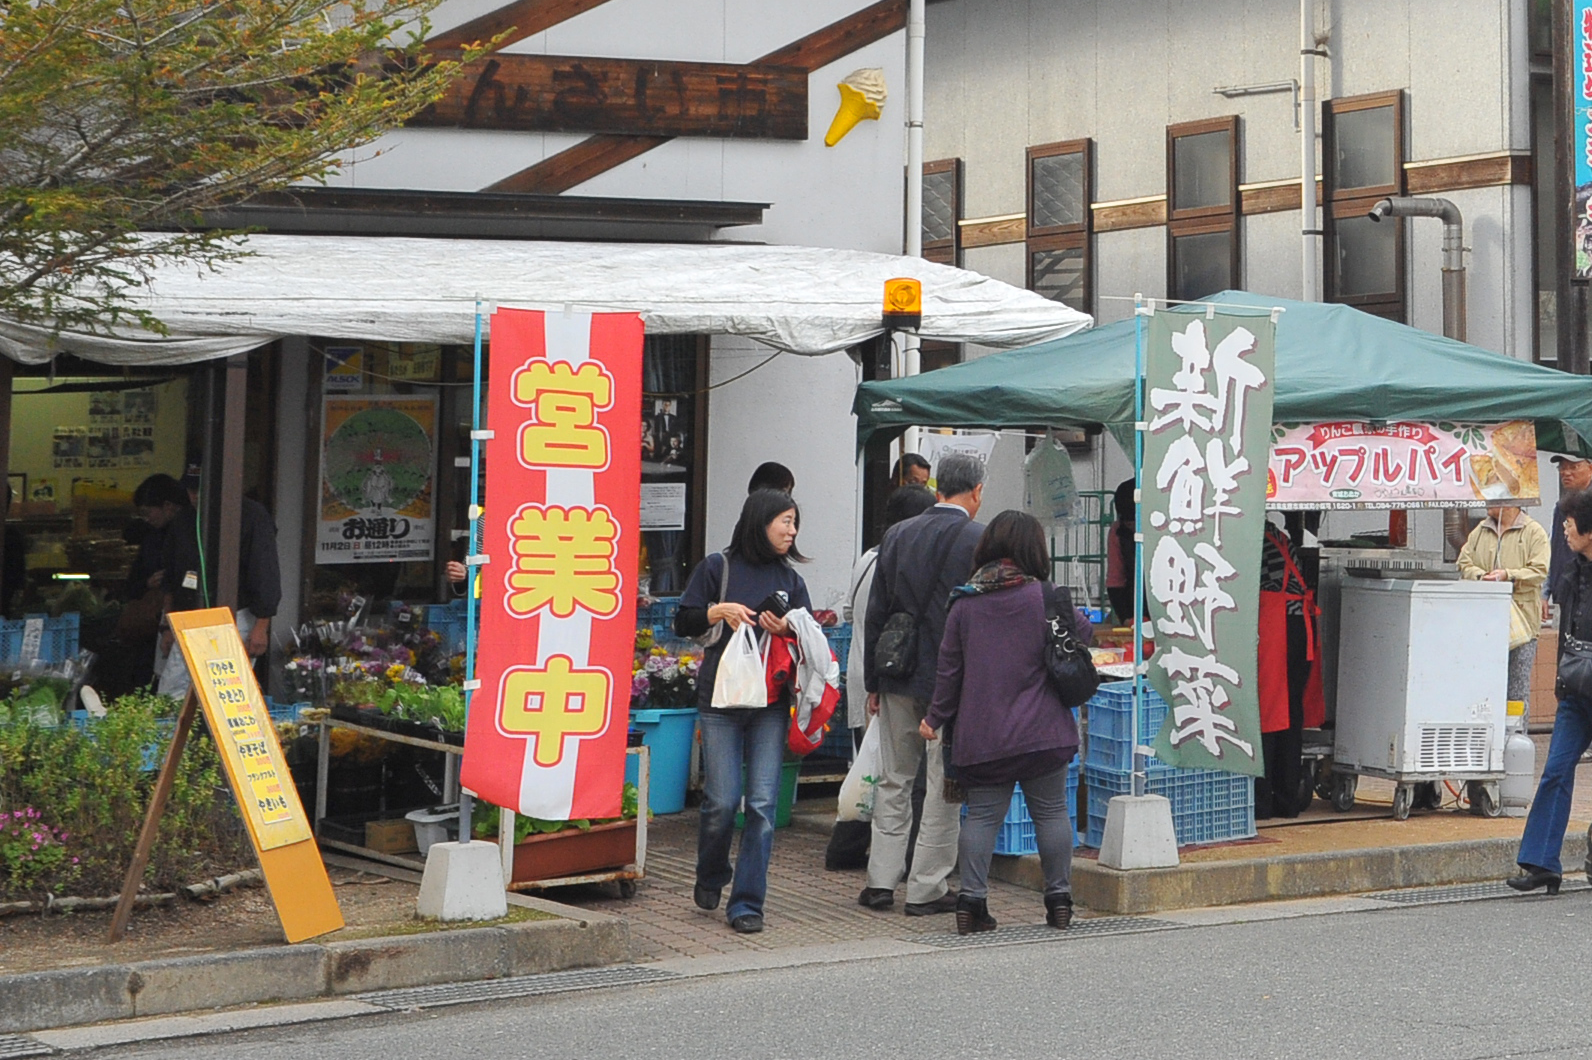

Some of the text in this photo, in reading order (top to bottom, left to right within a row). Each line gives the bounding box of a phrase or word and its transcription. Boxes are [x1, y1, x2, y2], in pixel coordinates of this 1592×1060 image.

[1273, 445, 1470, 488] アップルパイ
[342, 517, 411, 540] お通り
[1149, 318, 1266, 758] 新鮮野菜
[497, 358, 622, 768] 営業中
[218, 689, 245, 704] やきとり
[239, 741, 268, 758] やきそば
[258, 795, 288, 812] やきいも
